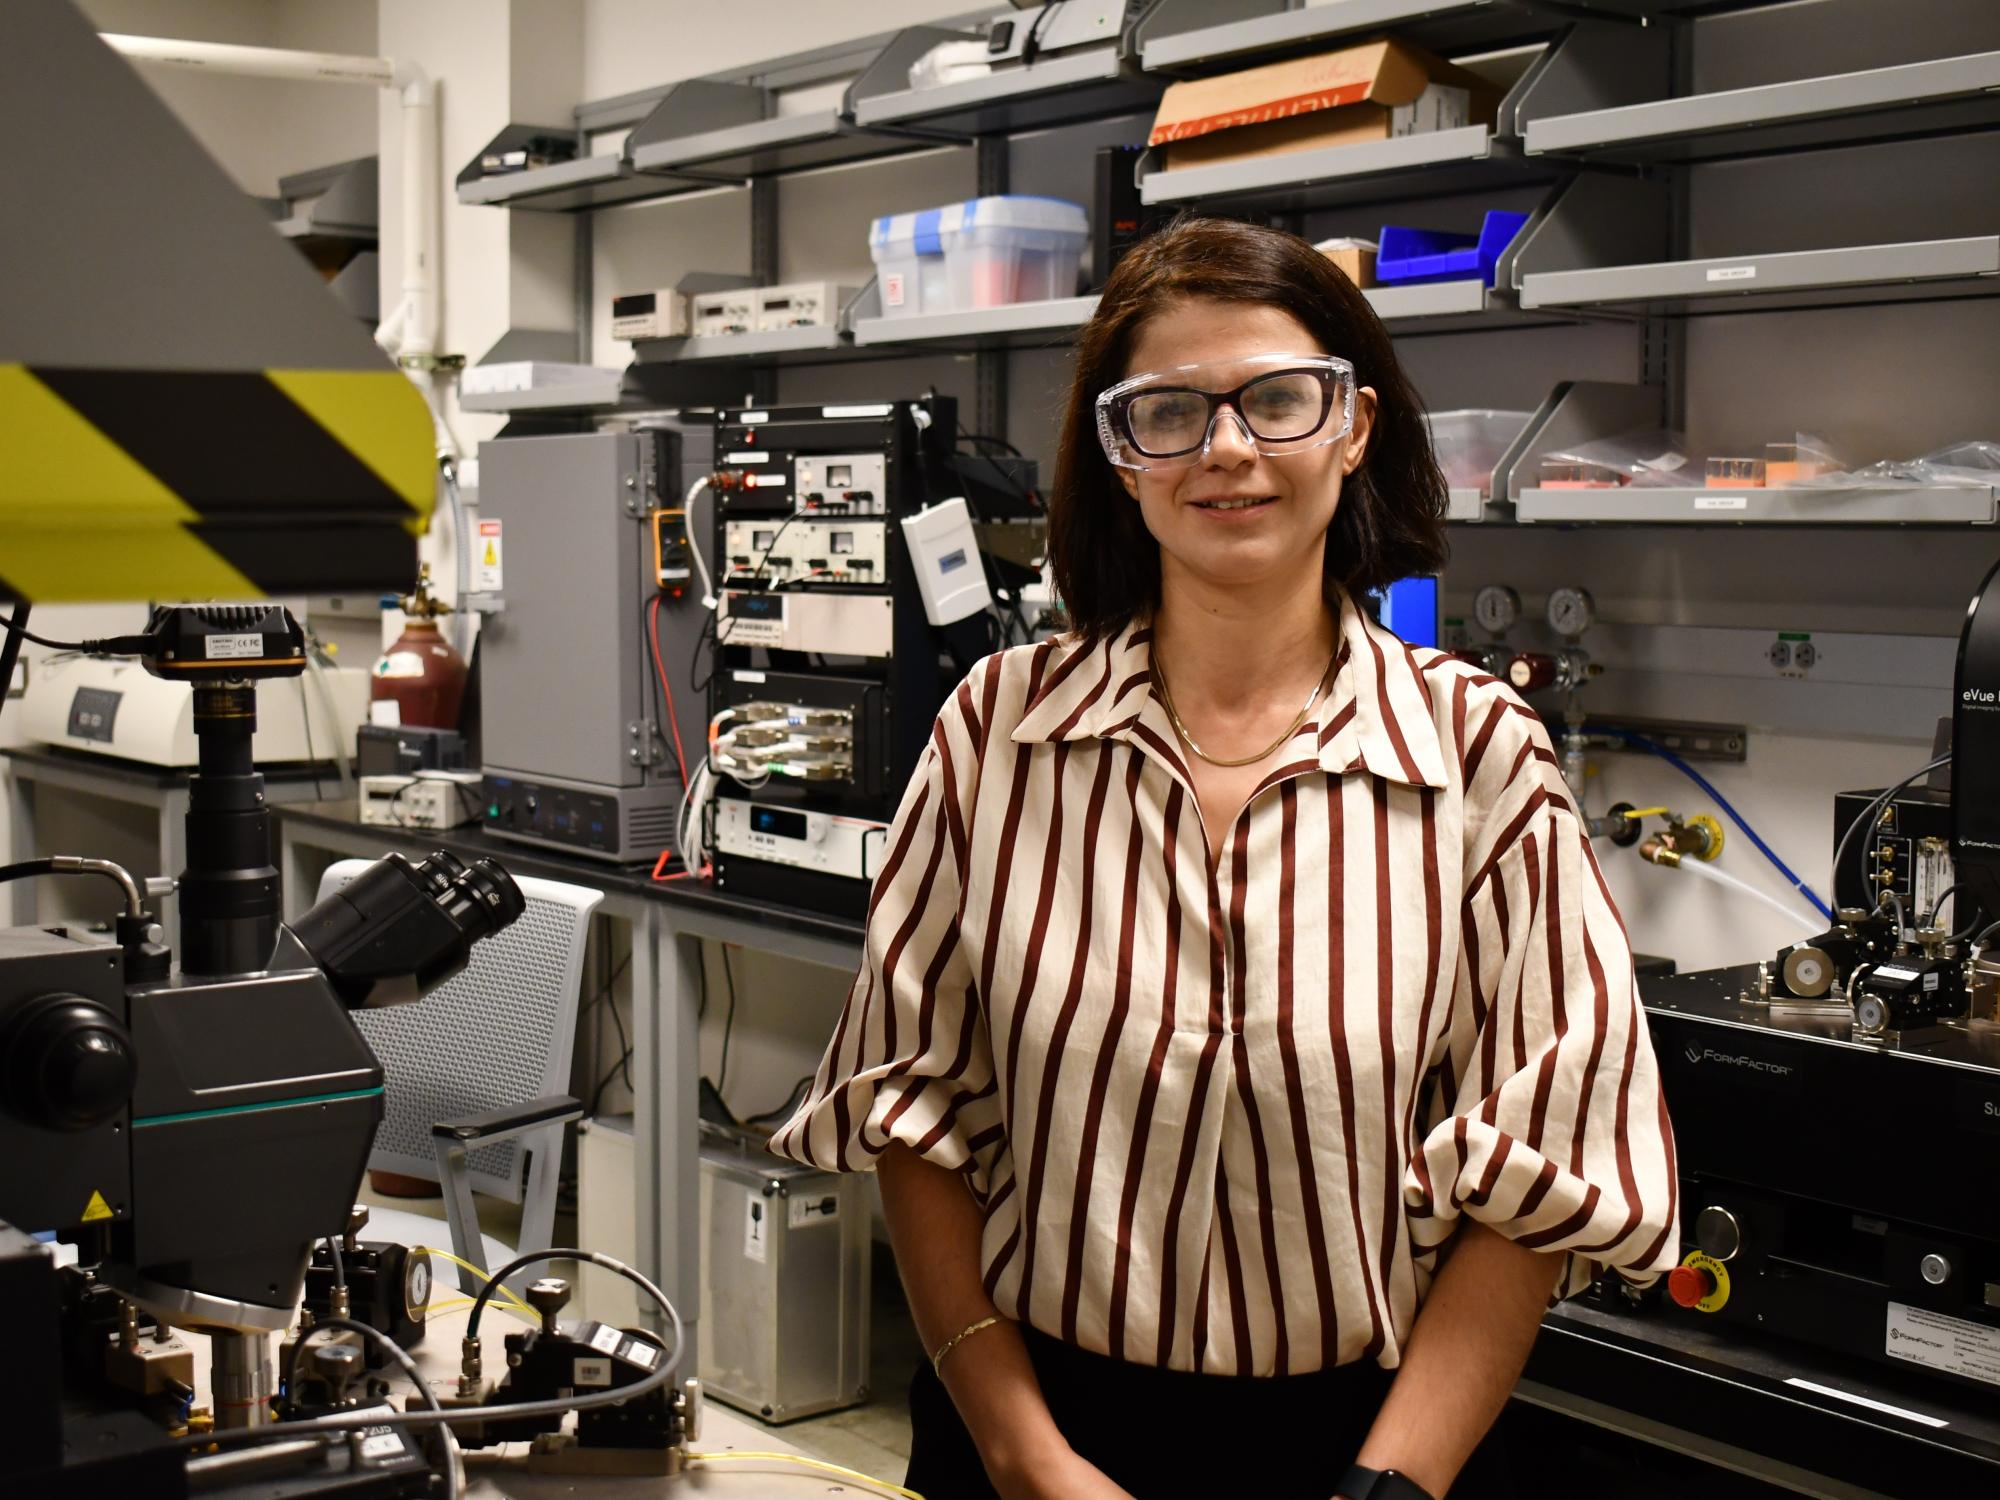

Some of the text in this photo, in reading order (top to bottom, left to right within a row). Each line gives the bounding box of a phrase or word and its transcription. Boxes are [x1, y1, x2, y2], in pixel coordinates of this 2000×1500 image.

[1963, 688, 1995, 702] eVue
[1703, 1049, 1793, 1075] FORMFACTOR
[1687, 1256, 1723, 1277] EMERGENCY
